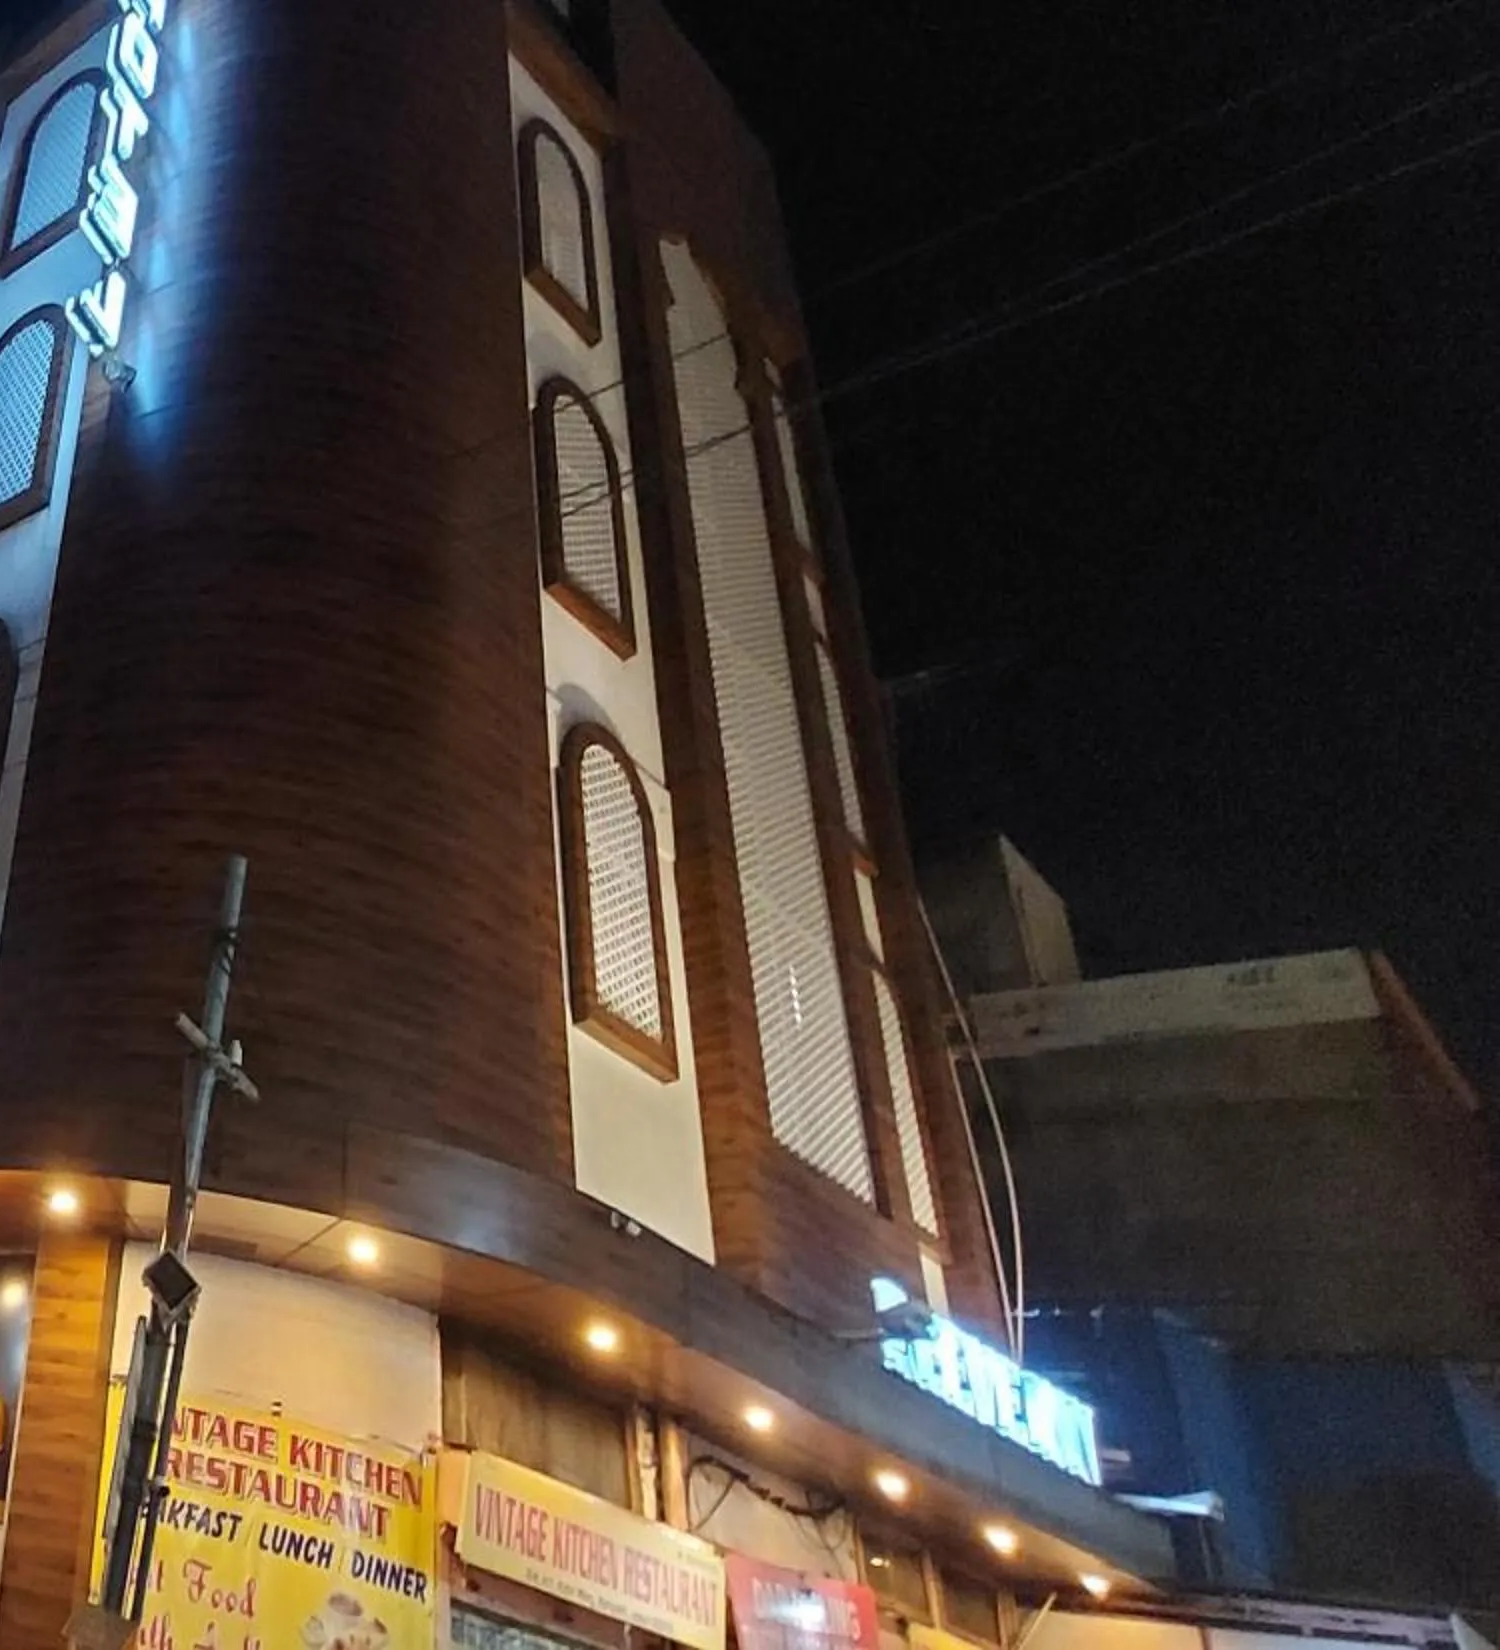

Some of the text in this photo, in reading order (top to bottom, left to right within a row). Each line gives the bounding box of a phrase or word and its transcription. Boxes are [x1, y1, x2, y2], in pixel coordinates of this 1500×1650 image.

[166, 1446, 389, 1538] RESTAURANT
[172, 1406, 423, 1509] NTAGE KITCHEN
[182, 1558, 257, 1619] Food
[258, 1521, 335, 1570] LUNCH
[351, 1549, 428, 1604] DINNER
[474, 1483, 549, 1562] VINTAGE
[552, 1516, 619, 1592] KITCHEN
[622, 1545, 718, 1628] RESTAURANT
